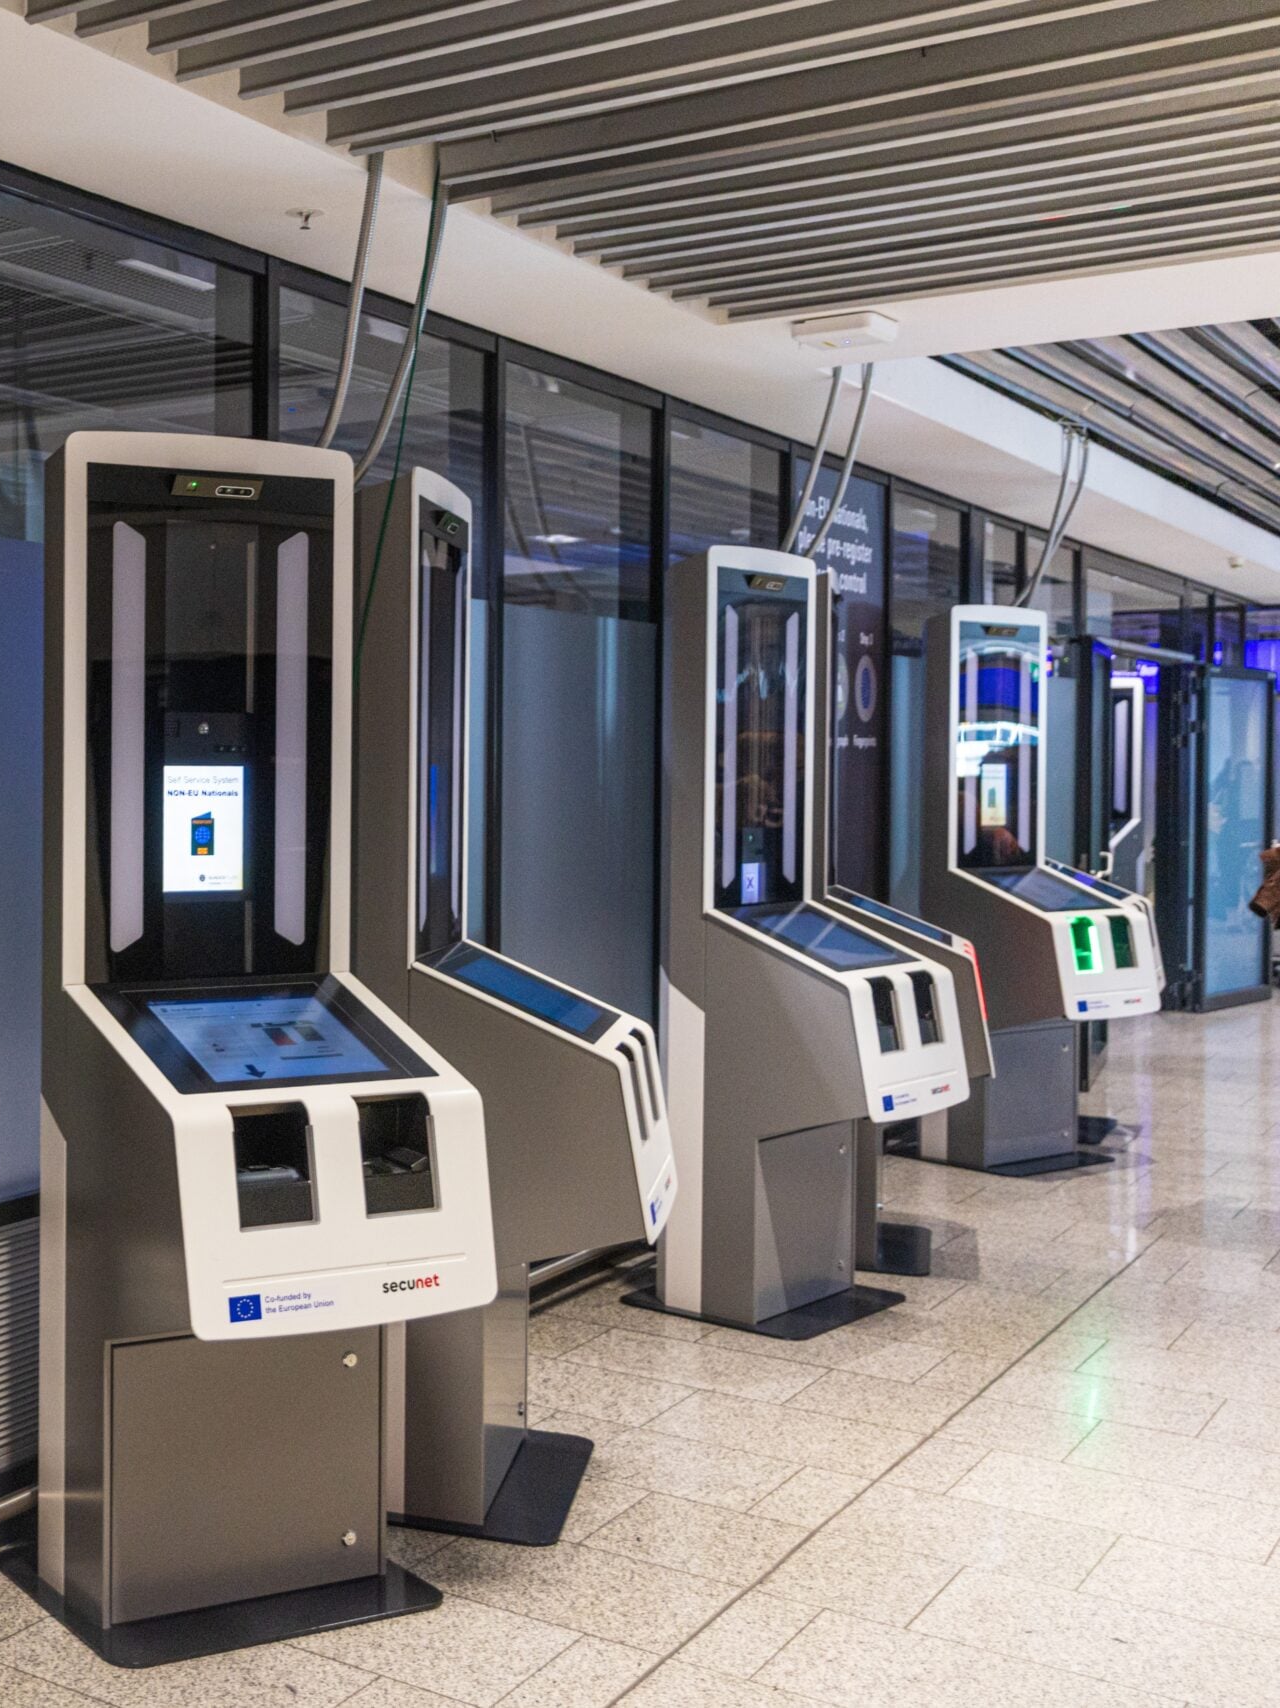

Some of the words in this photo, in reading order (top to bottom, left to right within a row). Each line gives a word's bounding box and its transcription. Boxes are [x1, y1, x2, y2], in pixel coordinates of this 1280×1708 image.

[381, 1273, 440, 1294] secunet
[265, 1293, 301, 1303] Co-funded
[302, 1291, 311, 1300] by
[265, 1305, 276, 1314] the
[278, 1302, 312, 1312] European
[313, 1300, 335, 1308] Union
